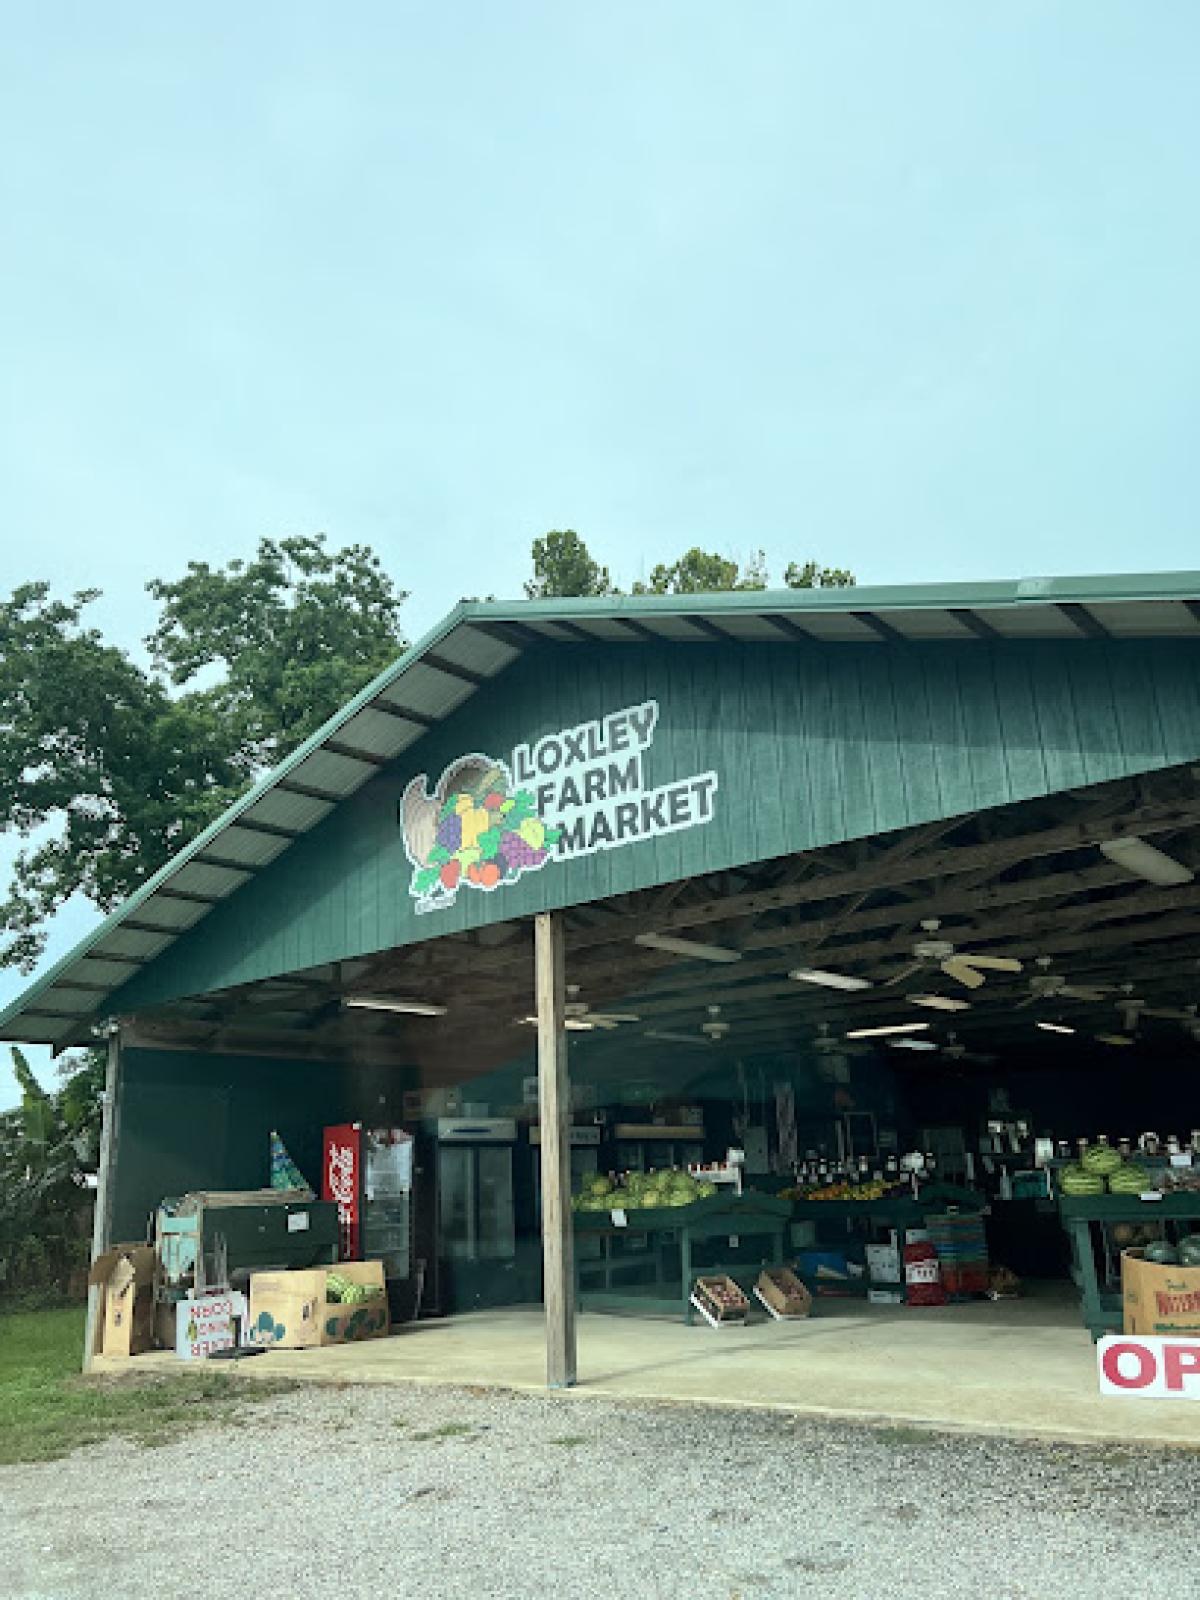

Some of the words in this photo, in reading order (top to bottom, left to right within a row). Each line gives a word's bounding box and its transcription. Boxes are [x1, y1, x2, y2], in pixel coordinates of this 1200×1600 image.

[515, 706, 655, 781] LOXLEY
[536, 755, 640, 818] FARM
[555, 777, 713, 855] MARKET
